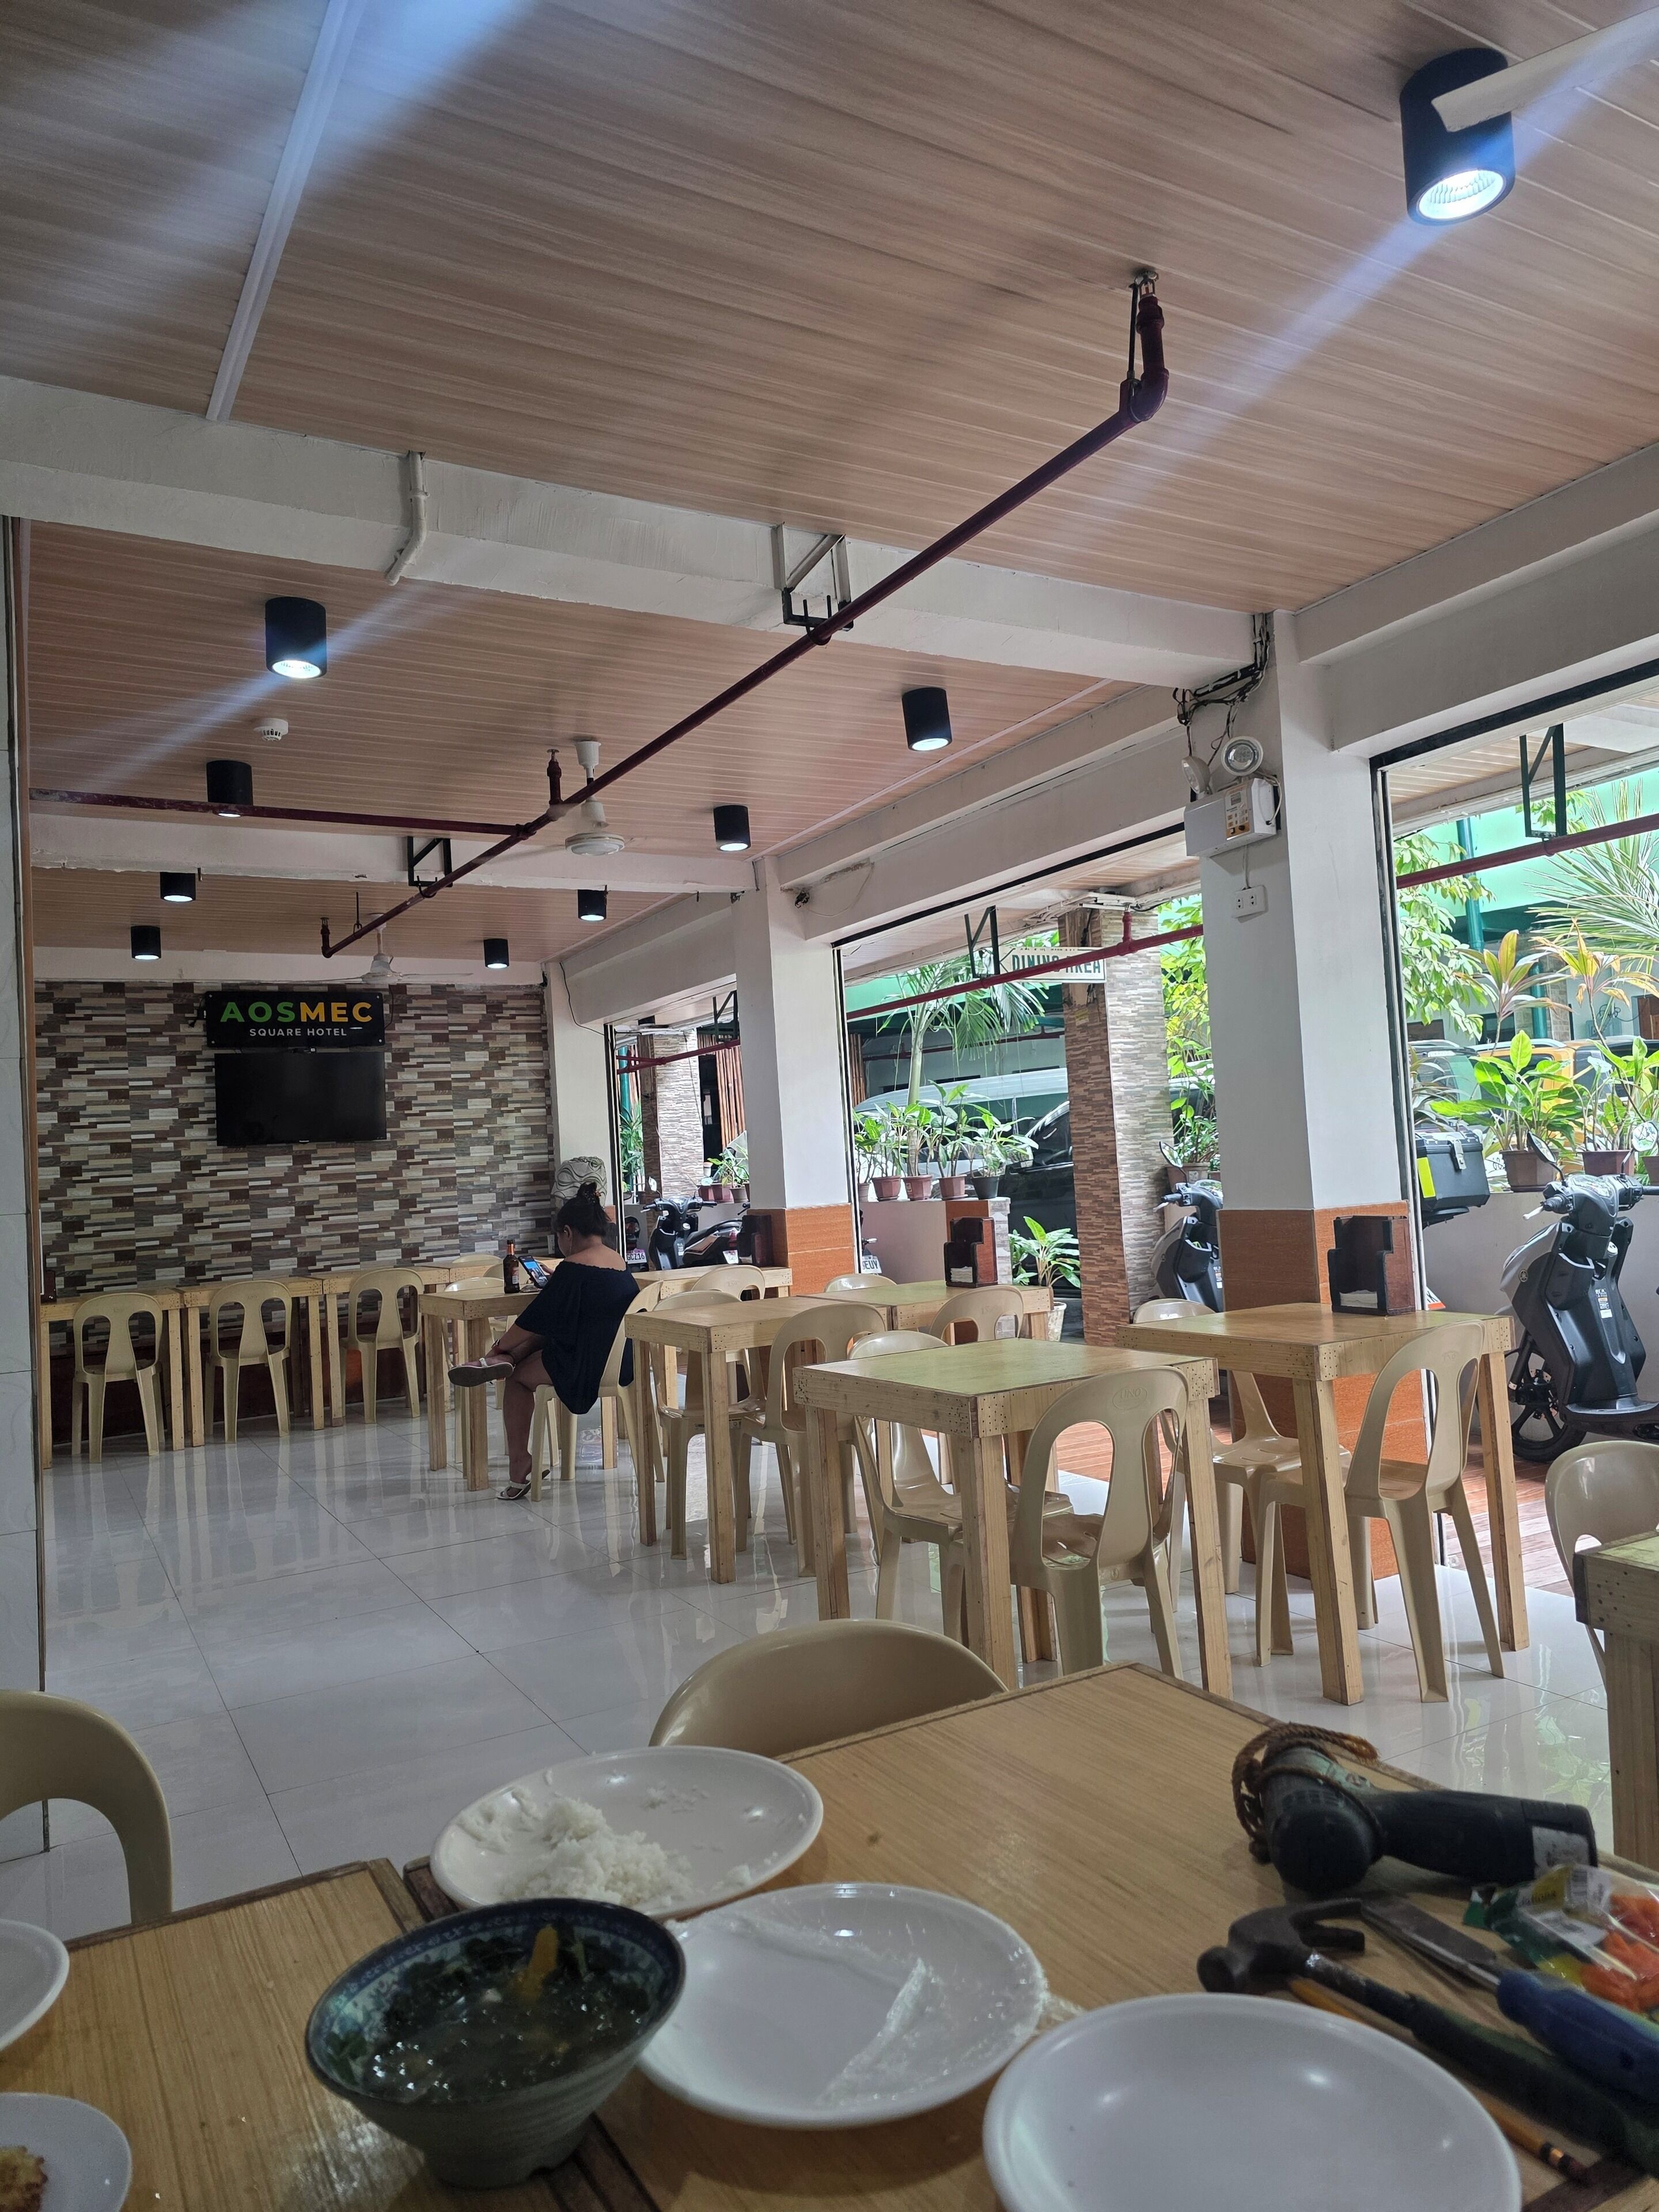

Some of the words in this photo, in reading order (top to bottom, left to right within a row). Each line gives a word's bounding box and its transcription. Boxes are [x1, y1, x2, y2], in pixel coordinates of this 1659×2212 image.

[220, 1002, 373, 1022] AOSMEC
[249, 1028, 301, 1037] SQUARE
[307, 1028, 347, 1036] HOTEL
